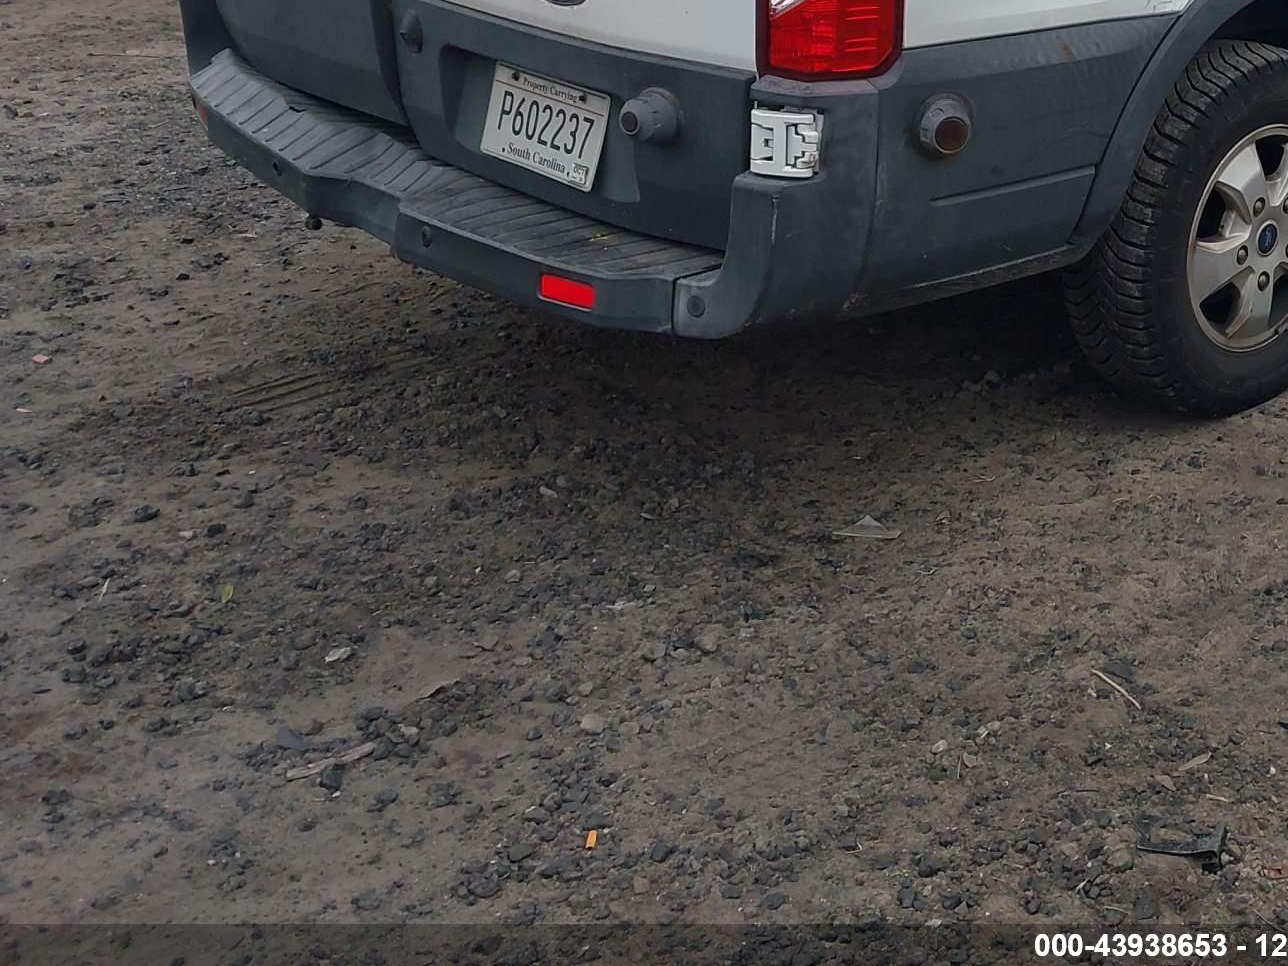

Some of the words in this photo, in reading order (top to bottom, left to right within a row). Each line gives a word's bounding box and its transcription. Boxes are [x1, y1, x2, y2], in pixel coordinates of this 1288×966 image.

[523, 76, 549, 96] Property
[497, 90, 595, 159] P602237
[507, 141, 531, 162] South
[532, 151, 565, 174] Carolina
